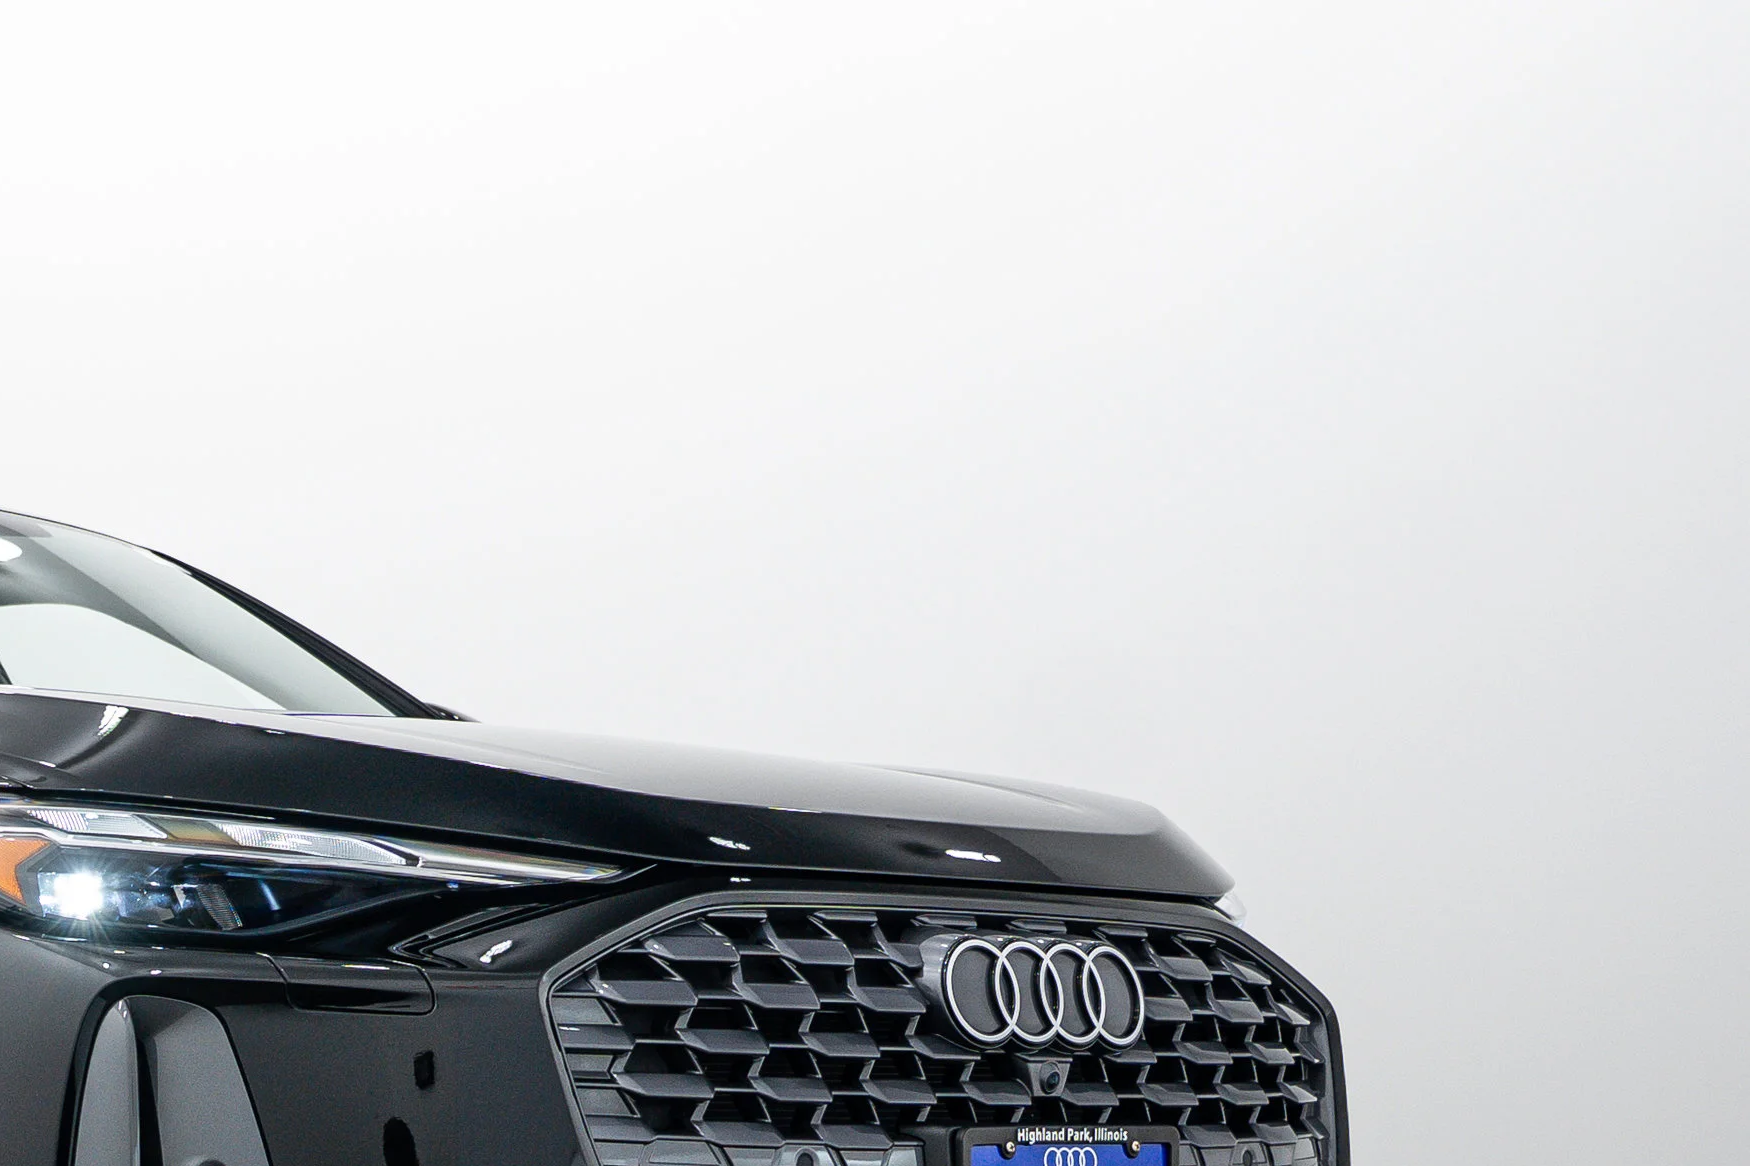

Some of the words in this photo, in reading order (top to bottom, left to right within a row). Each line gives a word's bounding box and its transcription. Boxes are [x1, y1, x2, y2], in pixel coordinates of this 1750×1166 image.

[1017, 1127, 1065, 1145] Highland
[1067, 1128, 1093, 1143] Park,
[1094, 1127, 1128, 1142] Illinois
